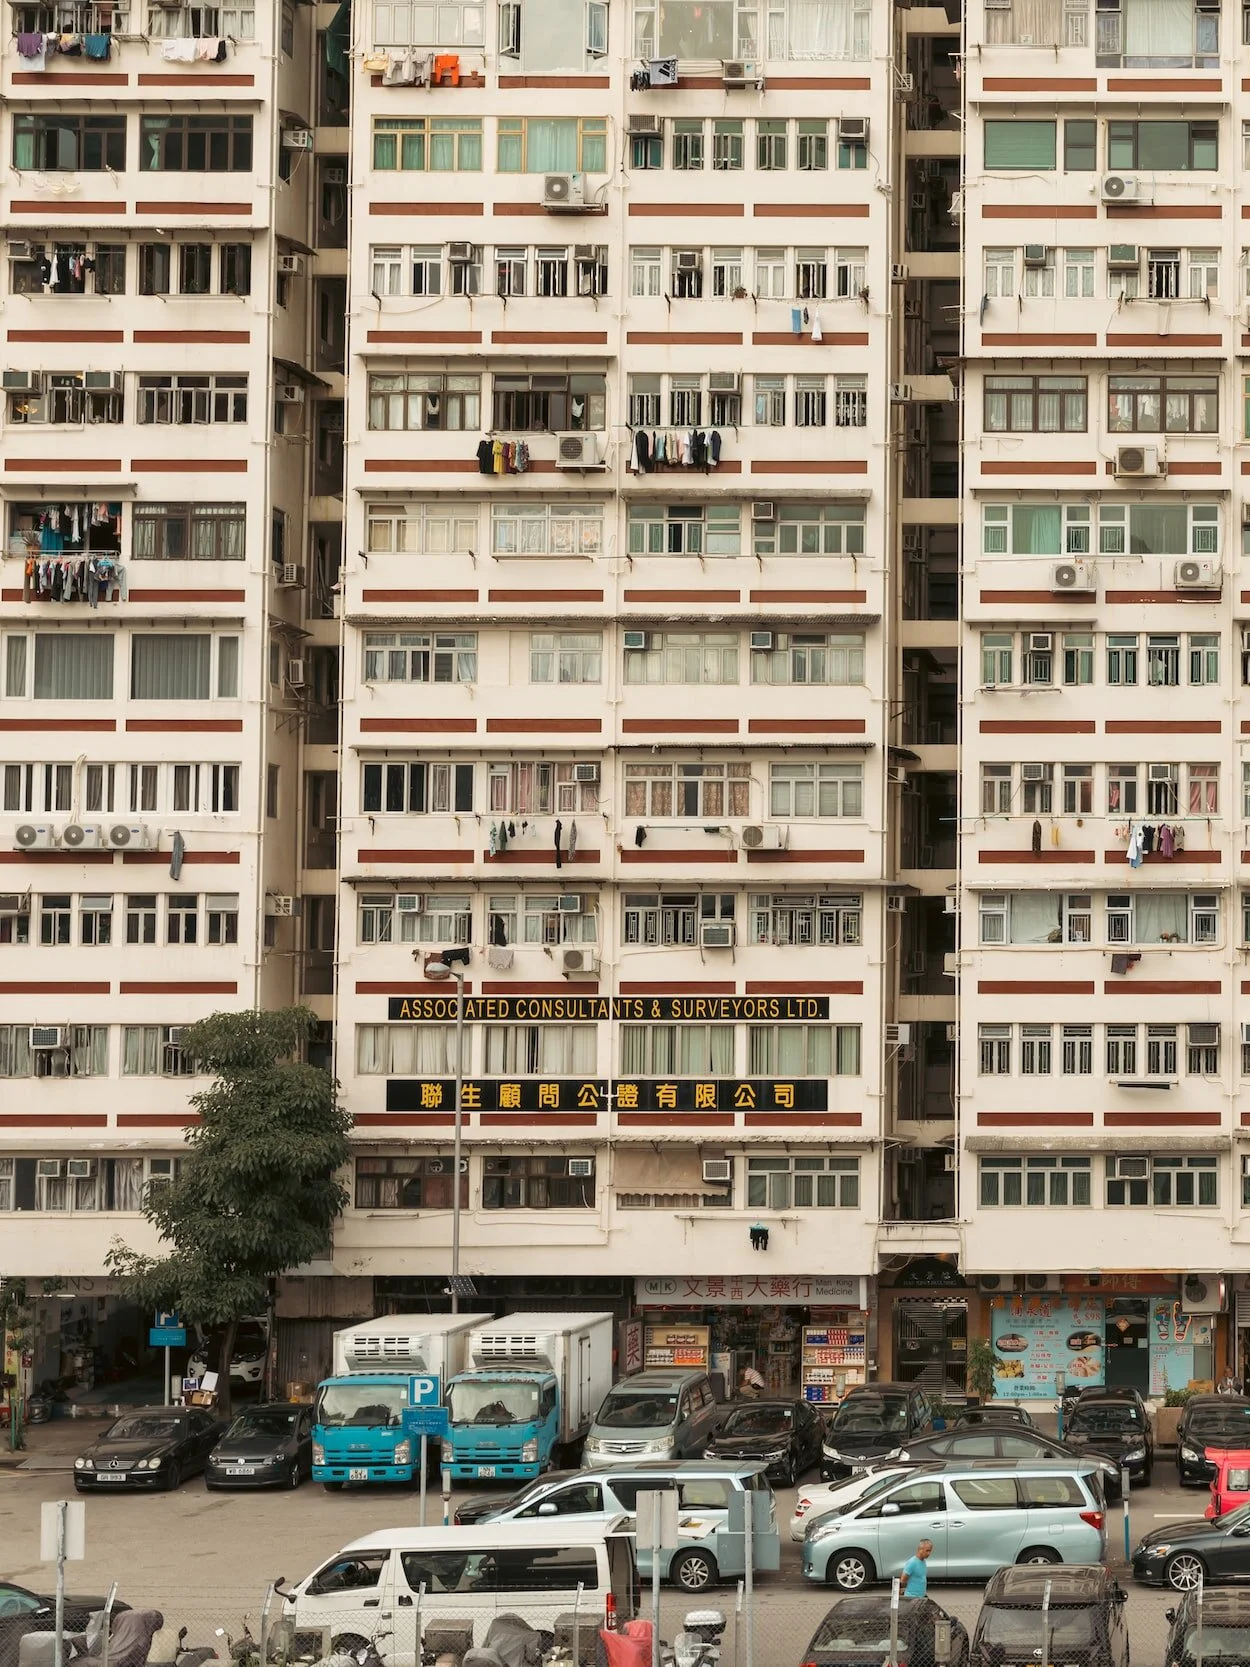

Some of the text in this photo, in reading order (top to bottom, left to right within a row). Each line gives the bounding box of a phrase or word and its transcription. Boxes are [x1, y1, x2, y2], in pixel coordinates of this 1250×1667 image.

[400, 999, 823, 1018] ASSOCATED CONSULTANTS & SURVEYORS LTD.
[420, 1082, 794, 1109] 聯生顧問公證有限公司
[815, 1279, 853, 1289] Man King
[815, 1287, 853, 1296] Medicine
[414, 1378, 434, 1403] P
